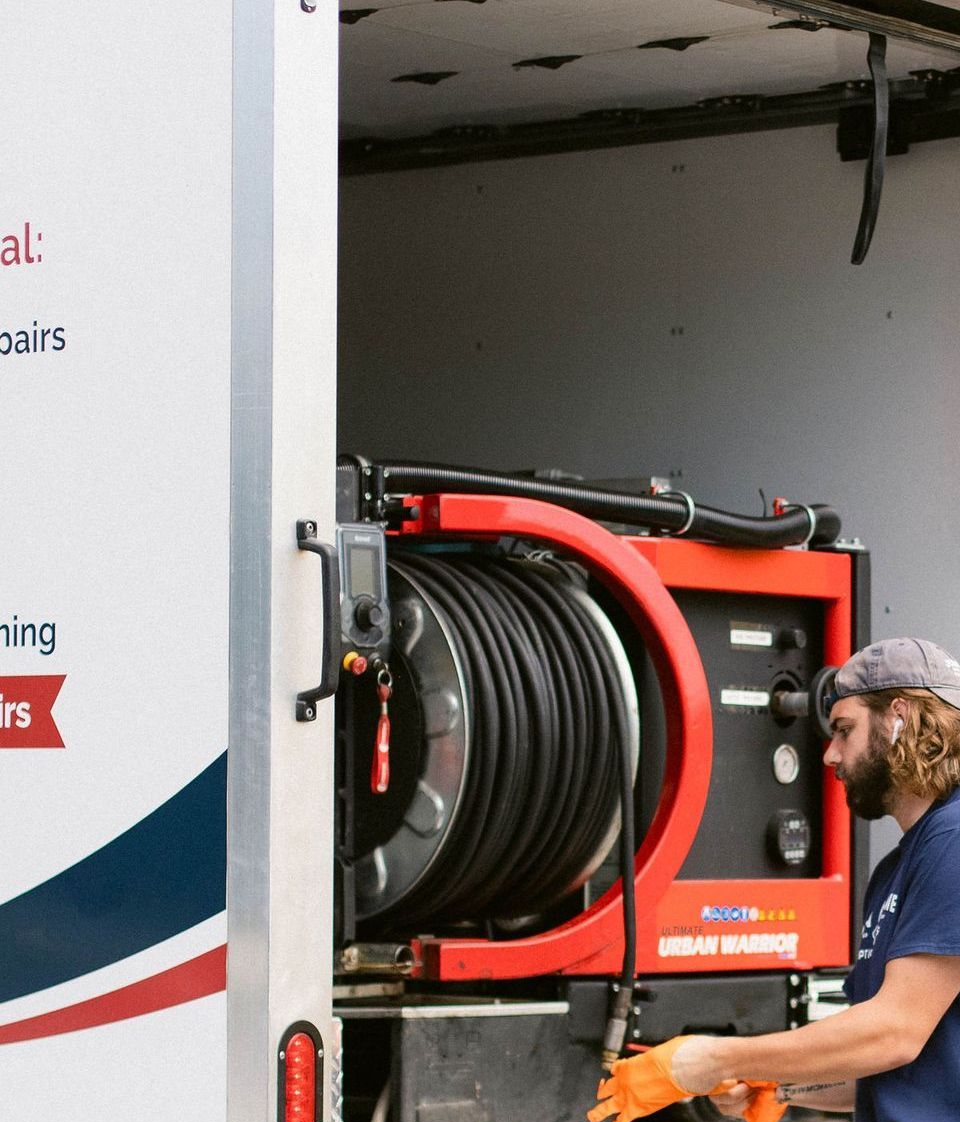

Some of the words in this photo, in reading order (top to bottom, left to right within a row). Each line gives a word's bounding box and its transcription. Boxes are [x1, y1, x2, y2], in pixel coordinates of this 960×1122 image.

[1, 222, 42, 266] al:
[658, 935, 719, 957] URBAN
[720, 932, 799, 956] WARRIOR
